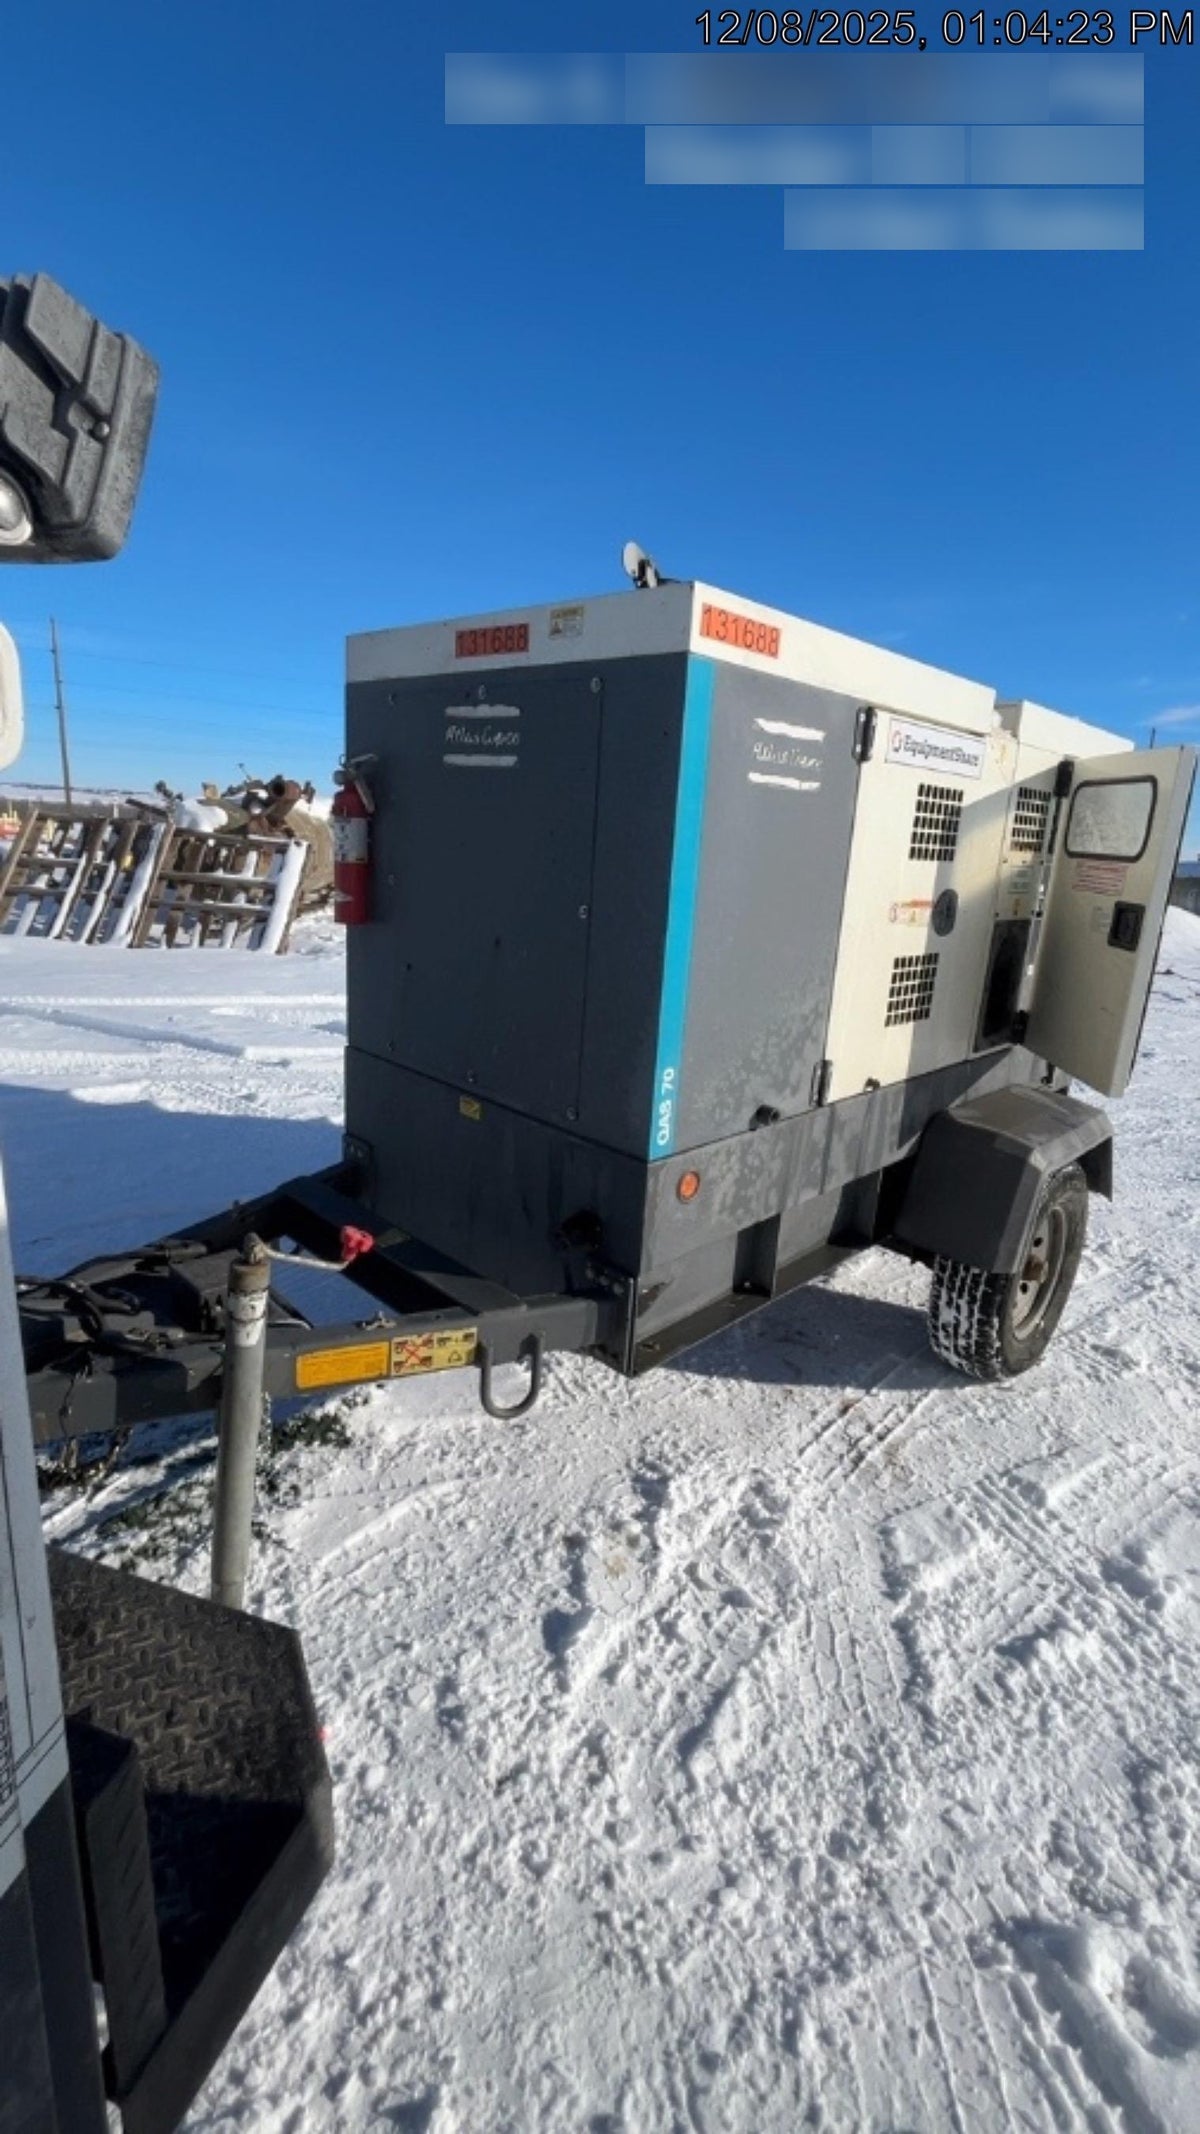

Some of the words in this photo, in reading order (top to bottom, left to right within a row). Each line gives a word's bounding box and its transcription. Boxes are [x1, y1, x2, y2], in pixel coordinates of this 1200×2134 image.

[456, 624, 529, 657] 131688
[702, 604, 779, 657] 131688
[661, 1068, 675, 1097] 70
[657, 1099, 672, 1146] QAS
